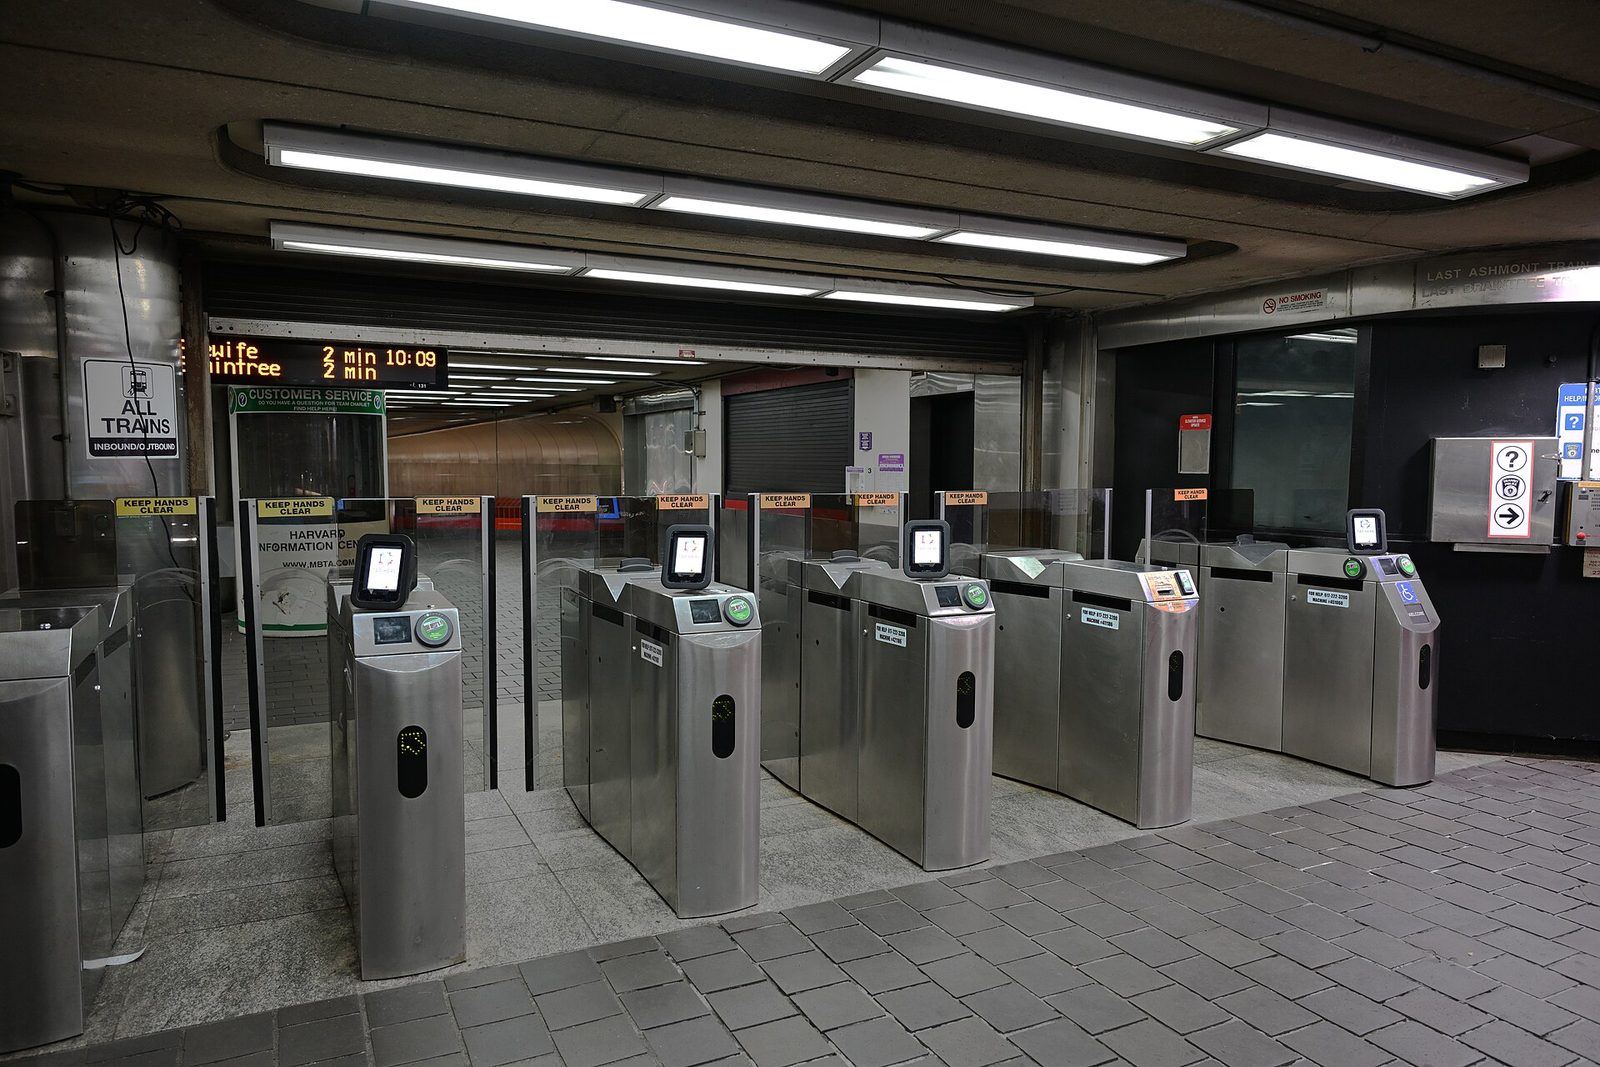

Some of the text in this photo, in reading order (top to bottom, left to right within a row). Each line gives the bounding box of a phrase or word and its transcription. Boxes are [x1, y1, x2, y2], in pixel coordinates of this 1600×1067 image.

[1427, 269, 1461, 281] LAST
[1469, 262, 1539, 277] ASHMONT
[1291, 292, 1322, 302] SMOKING
[1422, 286, 1457, 298] LAST
[322, 346, 335, 362] 2
[344, 347, 376, 365] min
[386, 349, 436, 367] 10:09
[323, 362, 335, 379] 2
[344, 362, 377, 380] min
[249, 389, 372, 402] CUSTOMER SERVICE
[101, 400, 170, 434] ALL TRAINS
[155, 499, 189, 507] HANDS
[265, 500, 325, 509] KEEP HANDS
[280, 507, 311, 515] CLEAR
[289, 529, 346, 540] HARVARD
[259, 541, 333, 552] NFORMATION
[282, 559, 355, 569] WWW.MBTA.COM
